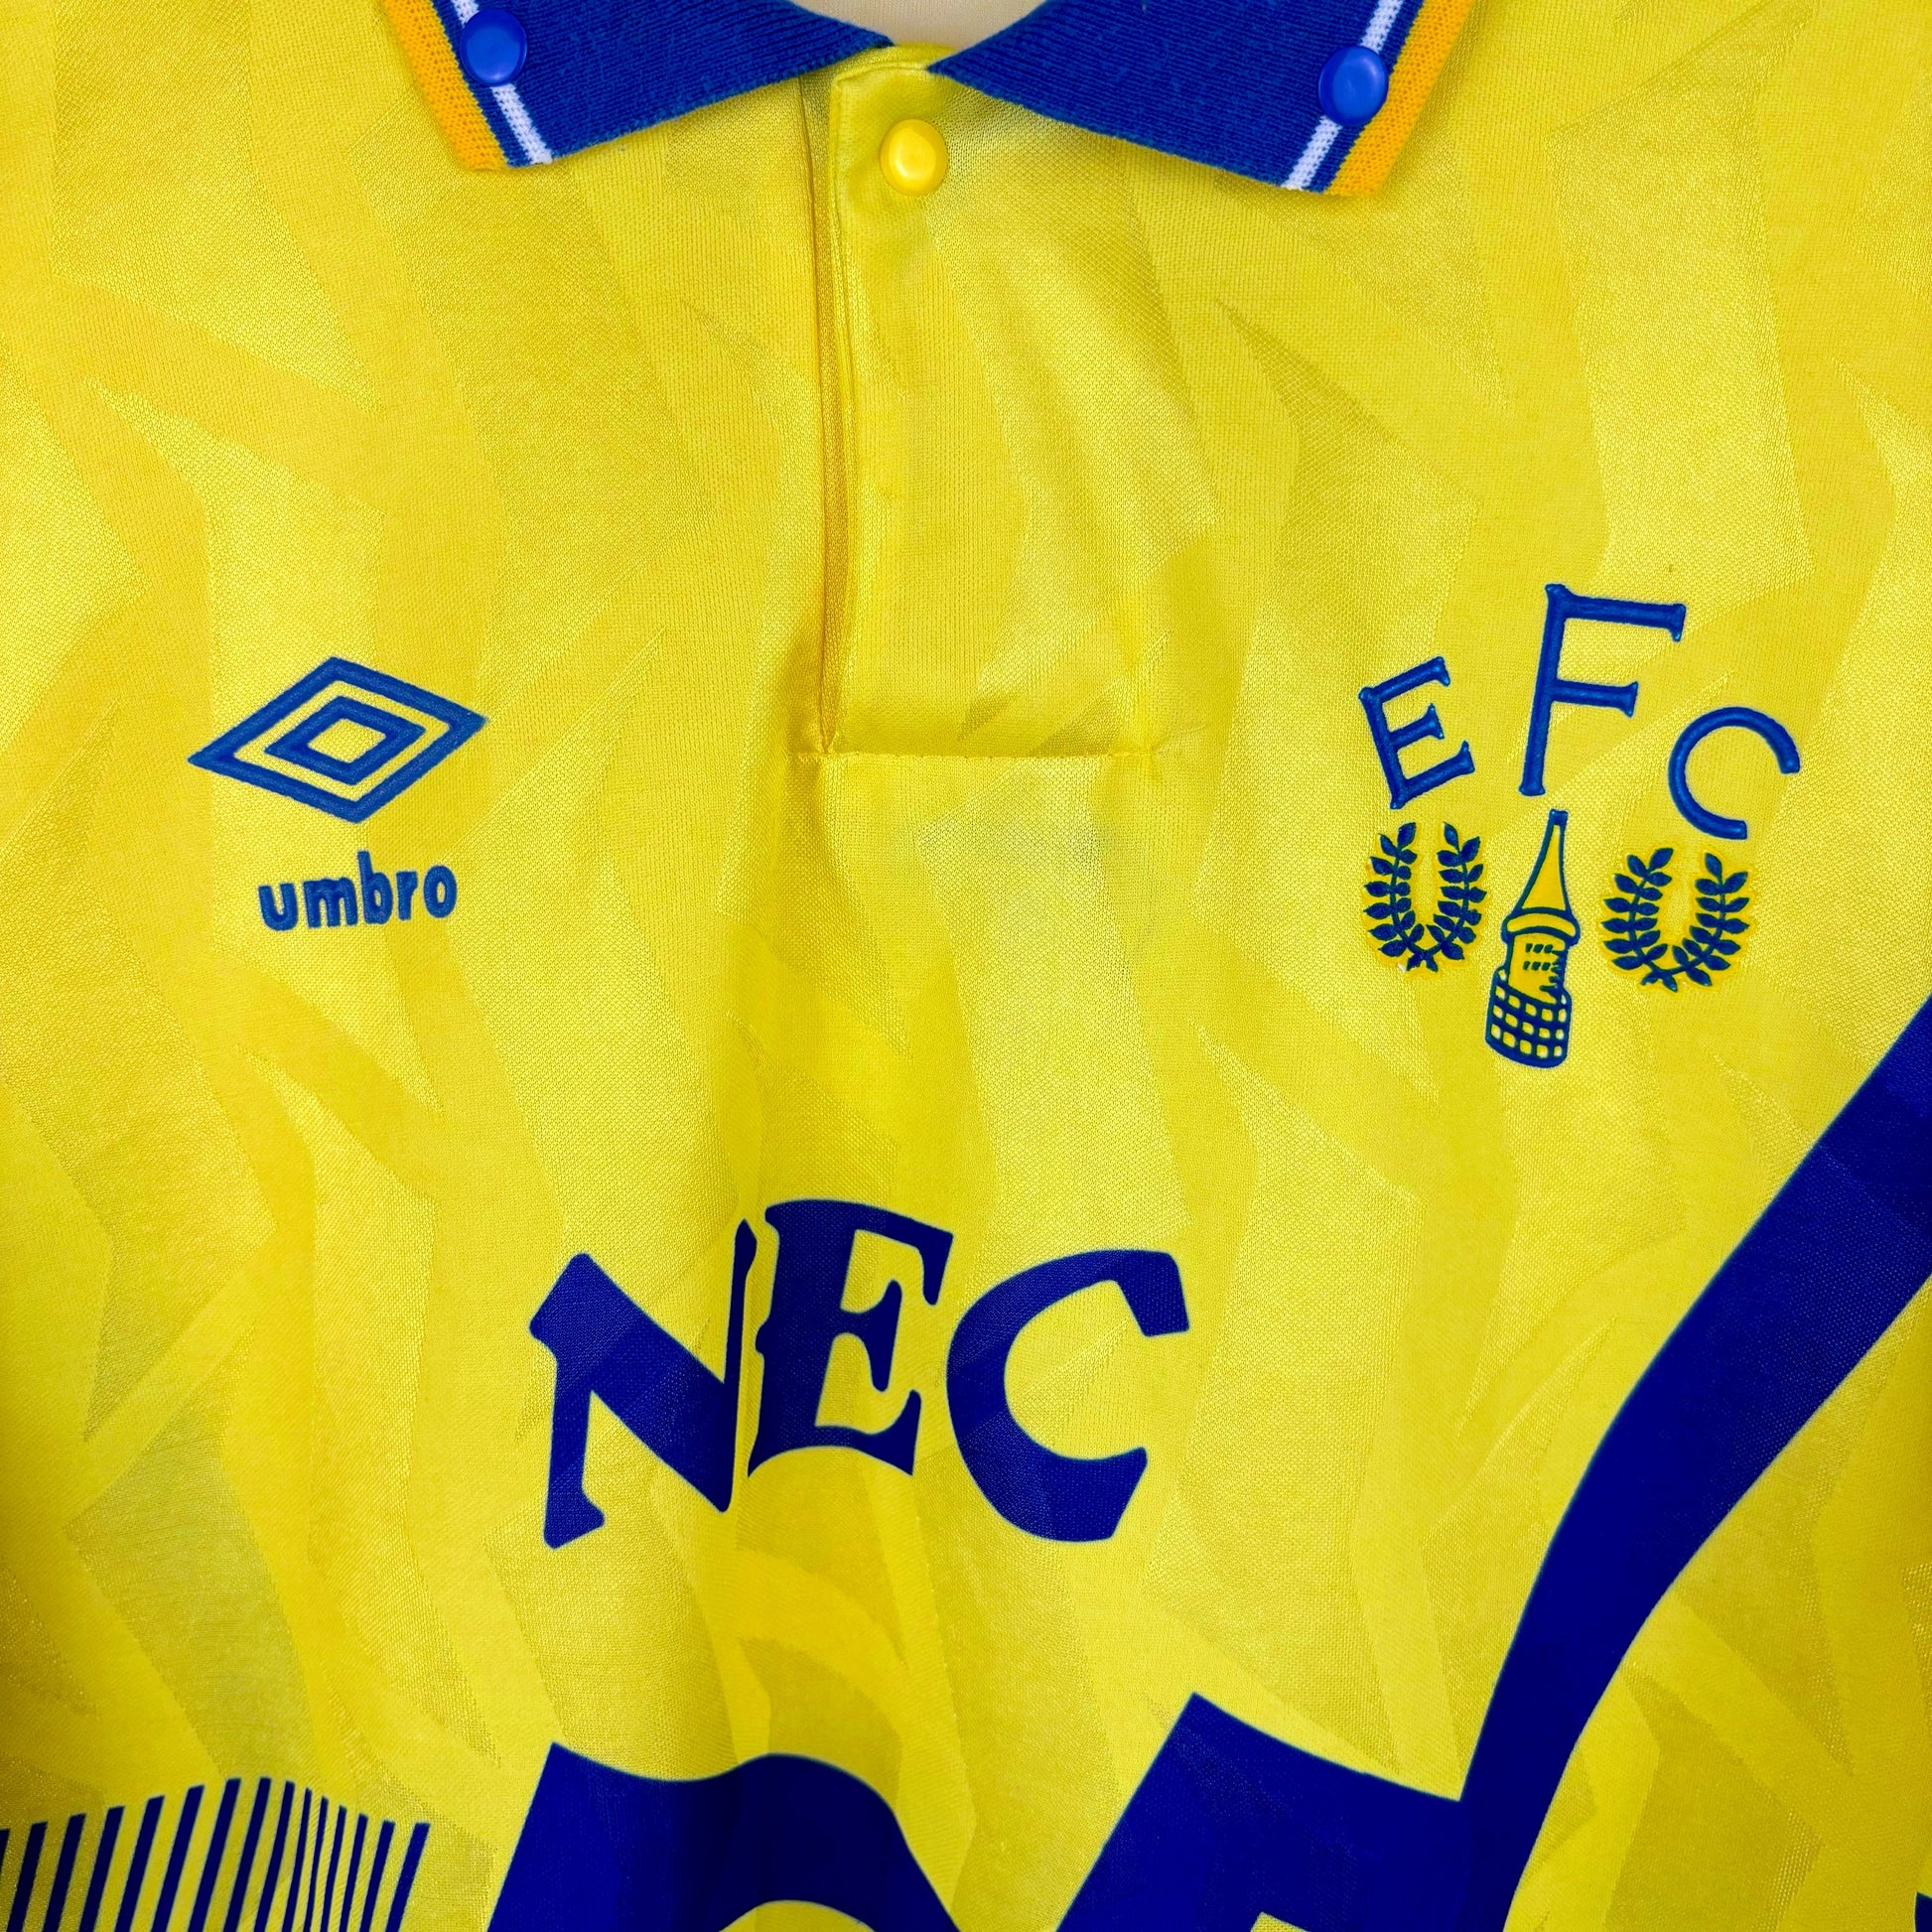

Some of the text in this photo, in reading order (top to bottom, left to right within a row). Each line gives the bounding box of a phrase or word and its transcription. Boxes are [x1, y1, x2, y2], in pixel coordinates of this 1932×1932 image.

[1358, 583, 1801, 841] EFC
[258, 850, 458, 931] umbro
[529, 1199, 1189, 1549] NEC
